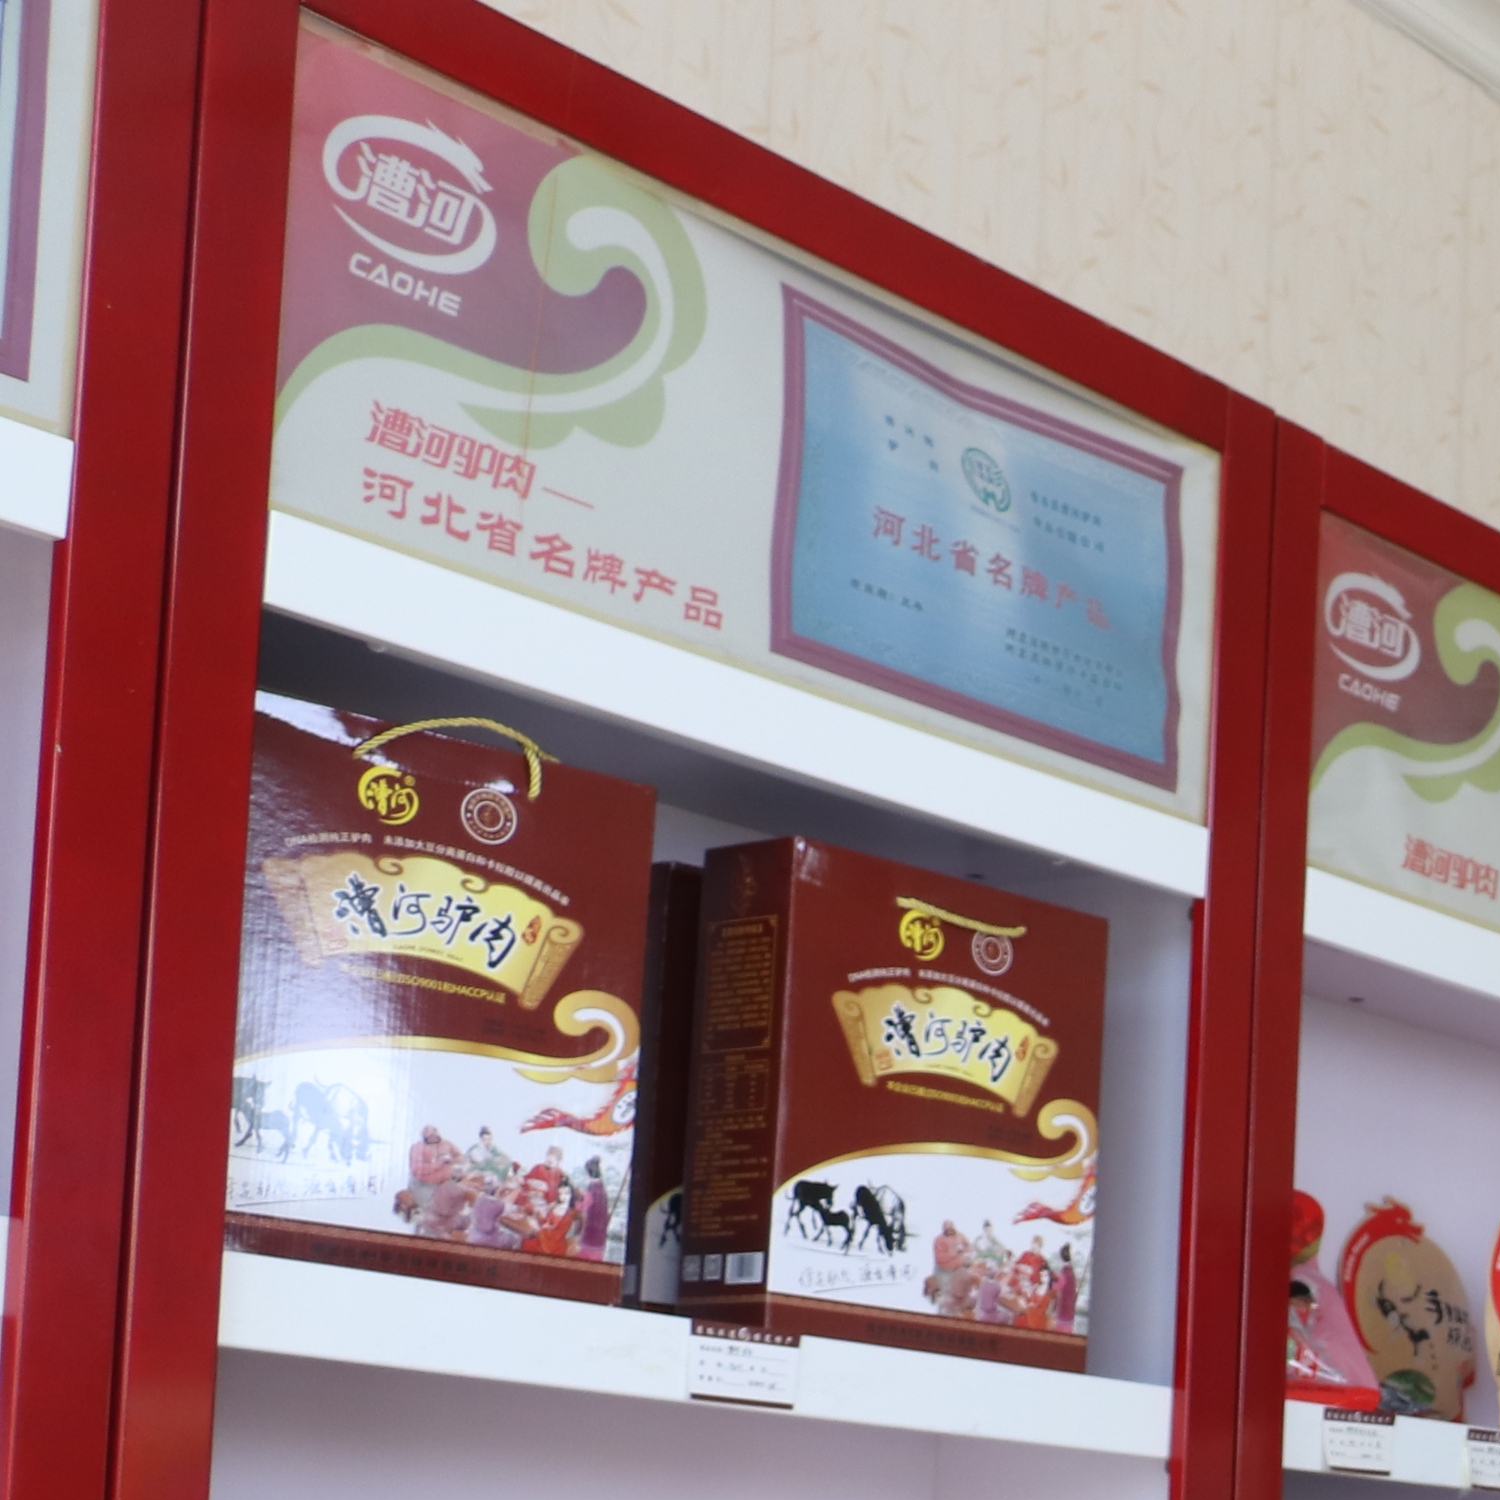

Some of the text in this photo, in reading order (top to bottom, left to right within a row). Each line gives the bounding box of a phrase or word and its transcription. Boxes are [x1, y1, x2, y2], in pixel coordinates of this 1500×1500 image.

[355, 143, 474, 246] 漕河
[348, 252, 463, 317] CAOHE
[362, 467, 724, 630] 河北省名牌产品
[1338, 591, 1405, 657] 漕河
[1337, 673, 1401, 712] CAOHE
[334, 872, 517, 970] 漕河驴肉
[884, 1005, 1012, 1083] 漕河驴肉
